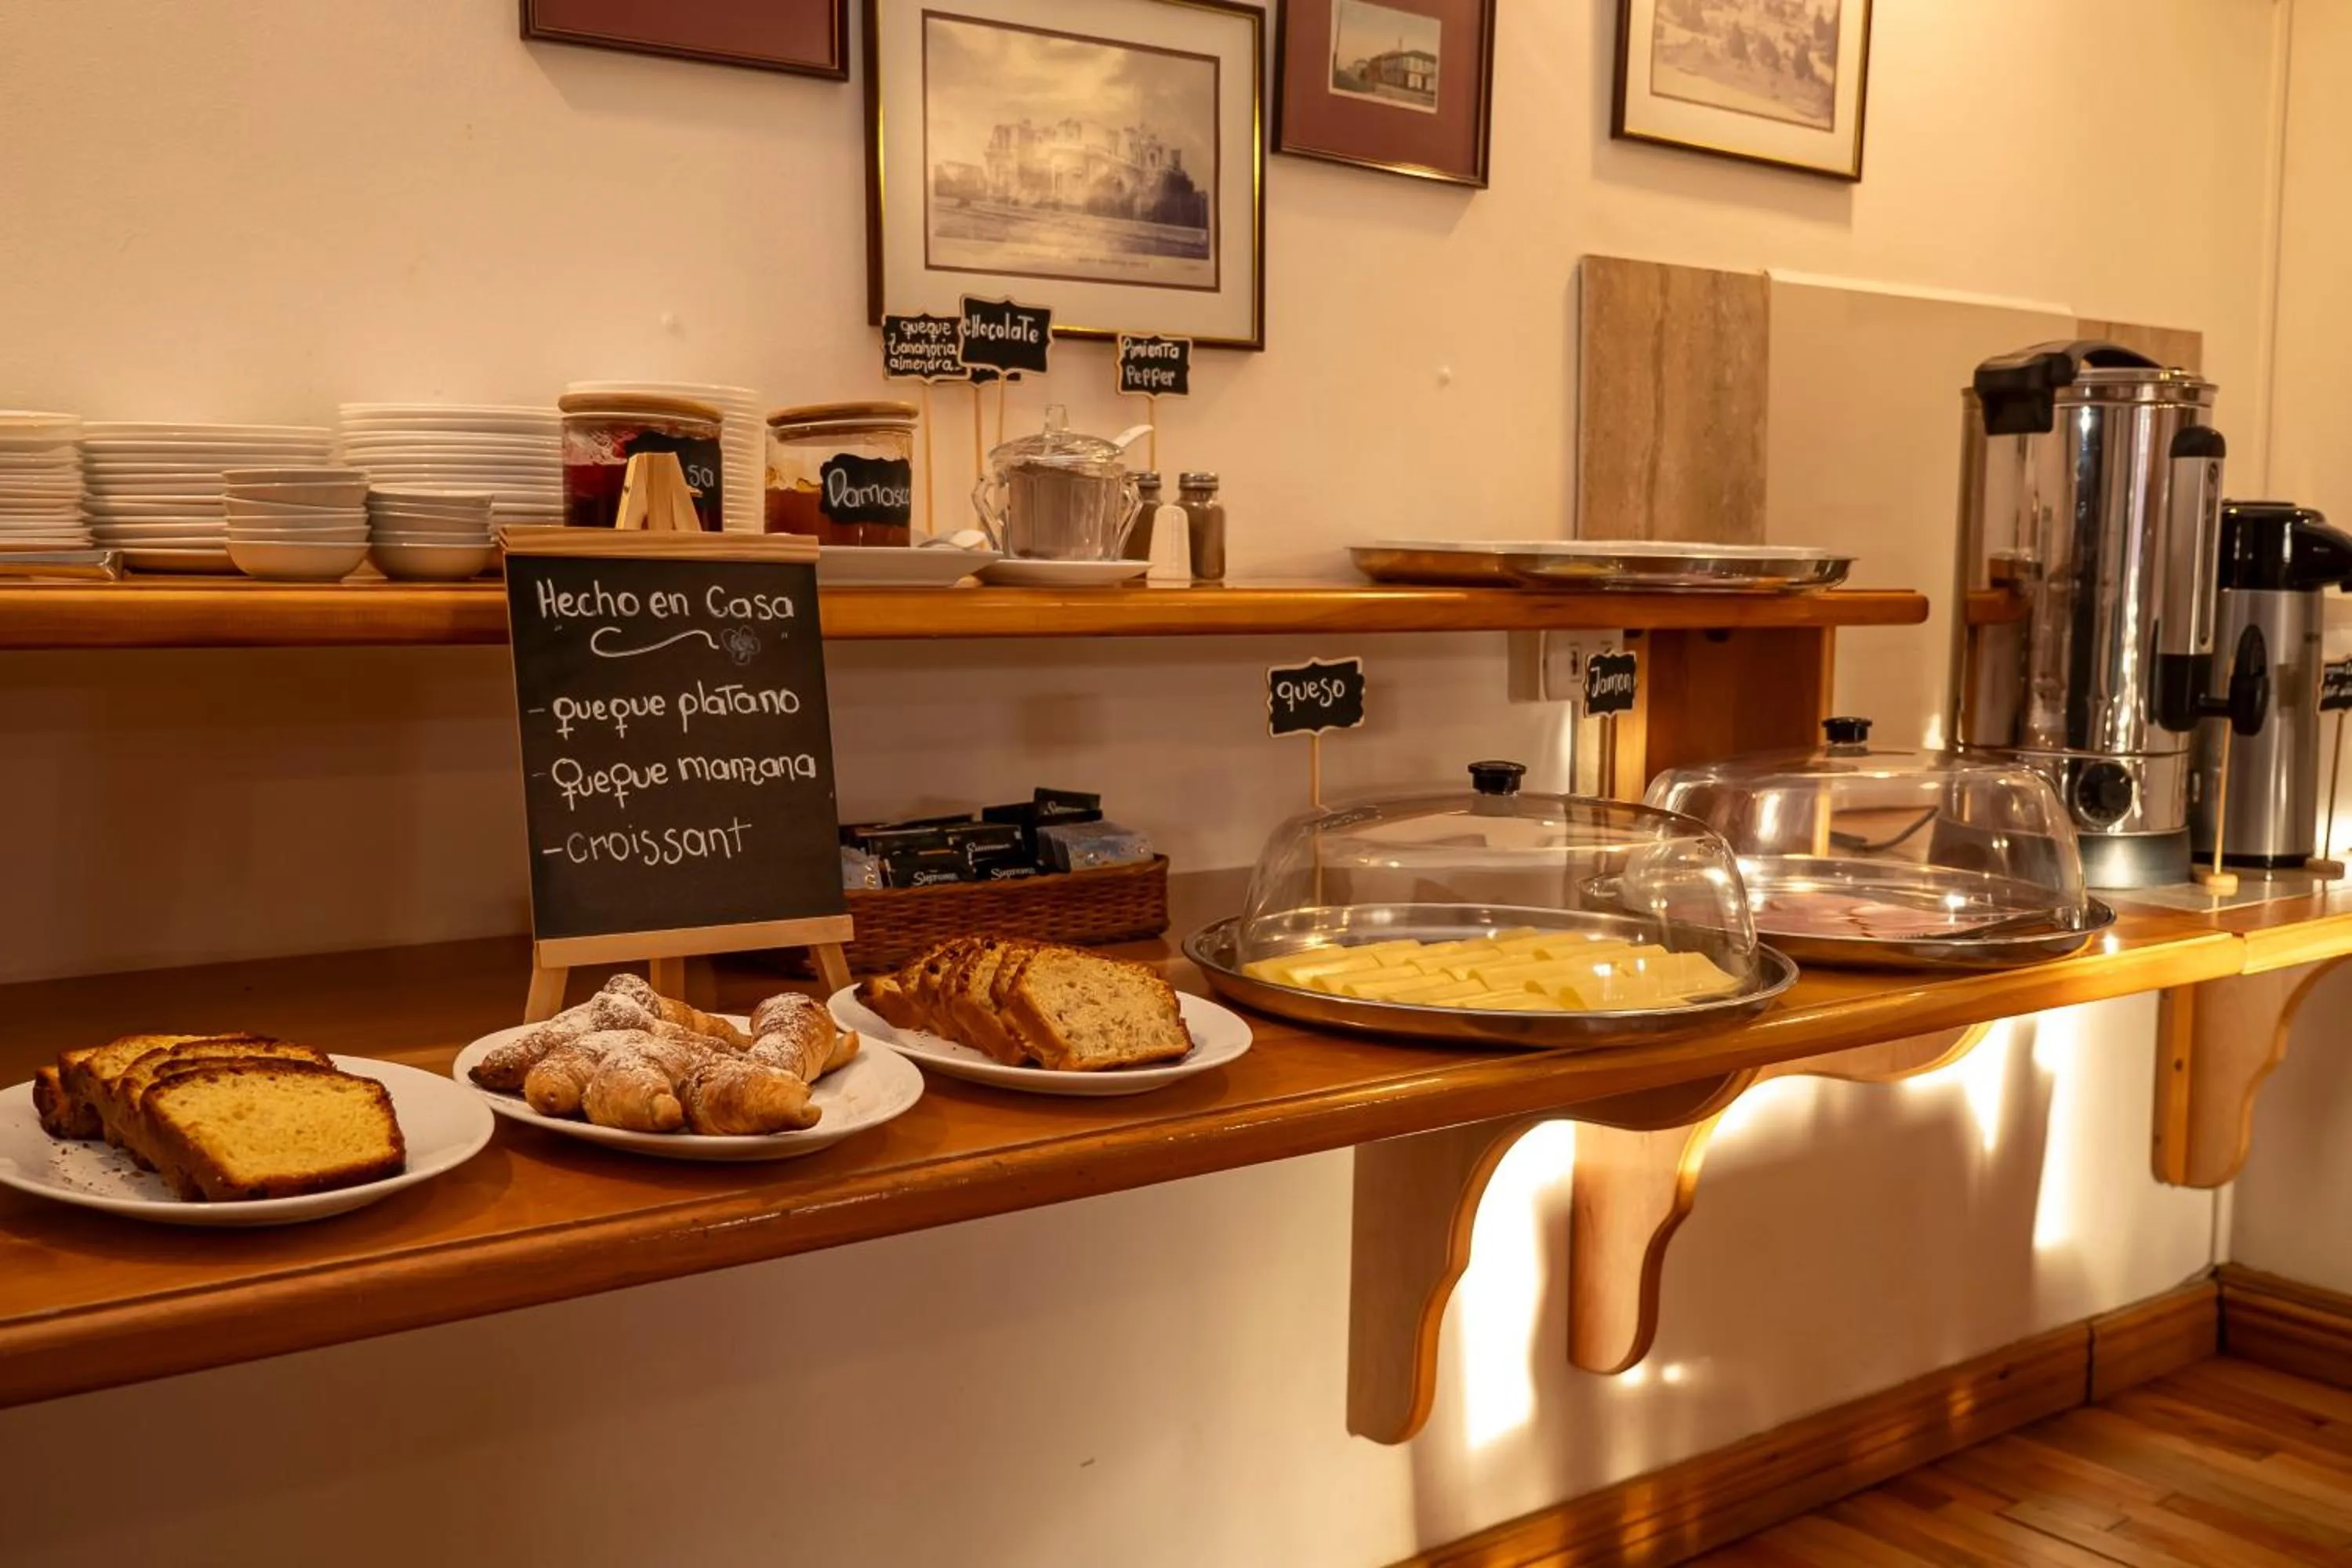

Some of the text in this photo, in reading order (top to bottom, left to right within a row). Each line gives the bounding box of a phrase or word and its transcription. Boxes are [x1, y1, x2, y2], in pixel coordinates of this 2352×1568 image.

[536, 578, 795, 620] Hecho en Casa
[1276, 677, 1345, 713] queso
[677, 753, 816, 785] manzana
